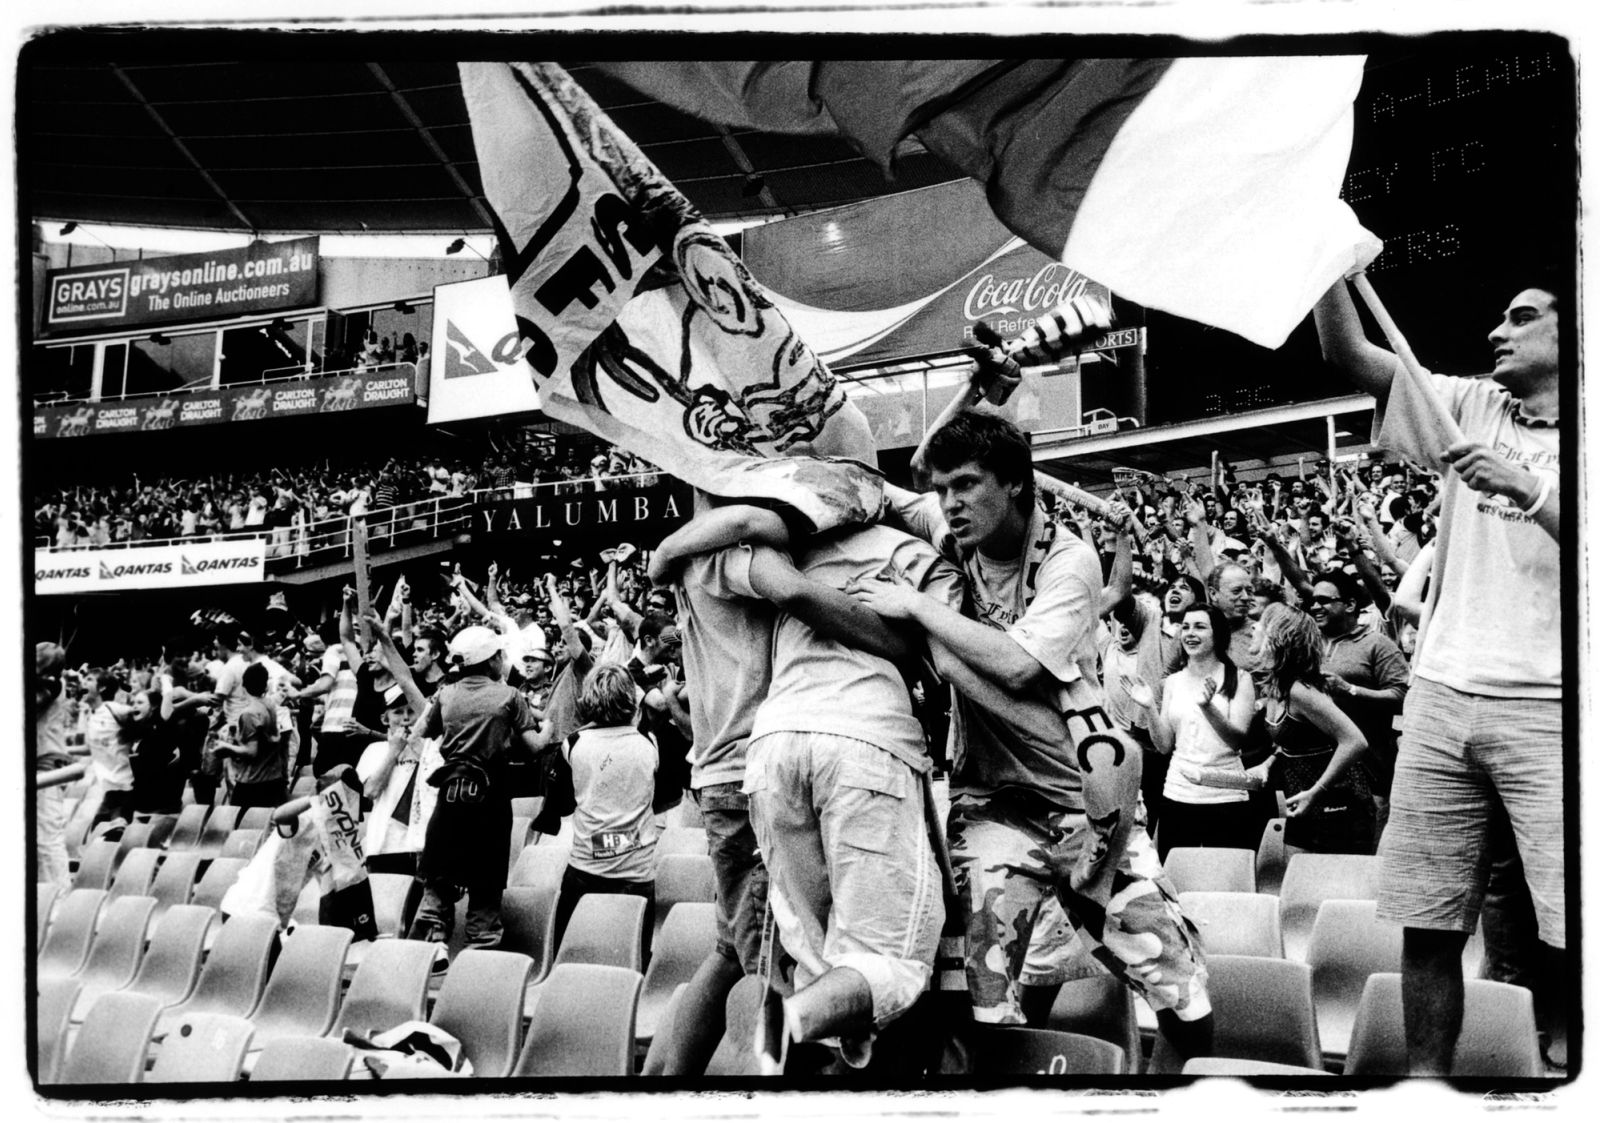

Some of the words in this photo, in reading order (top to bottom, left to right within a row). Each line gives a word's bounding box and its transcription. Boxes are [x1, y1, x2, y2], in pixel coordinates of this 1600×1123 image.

[1341, 161, 1399, 203] EY
[1431, 140, 1487, 182] FC
[1371, 224, 1461, 272] ERS
[129, 253, 313, 297] graysonline.com.au
[57, 277, 122, 303] GRAYS
[148, 294, 170, 312] The
[173, 291, 212, 309] Online
[215, 282, 290, 304] Auctioneers
[963, 262, 1088, 321] Coca-Cola
[56, 300, 120, 315] online.com.au
[998, 317, 1037, 334] Refre
[1094, 331, 1133, 348] ORTS
[365, 378, 409, 392] CARLTON
[275, 388, 316, 401] CARLTON
[363, 388, 410, 402] DRAUGHT
[182, 399, 221, 411] CARLTON
[273, 397, 317, 411] DRAUGHT
[98, 408, 137, 420] CARLTON
[180, 408, 223, 421] DRAUGHT
[96, 417, 139, 429] DRAUGHT
[483, 493, 681, 532] YALUMBA
[113, 562, 173, 578] QANTAS
[196, 556, 260, 573] QANTAS
[34, 567, 91, 581] QANTAS
[325, 790, 364, 861] SYDNE
